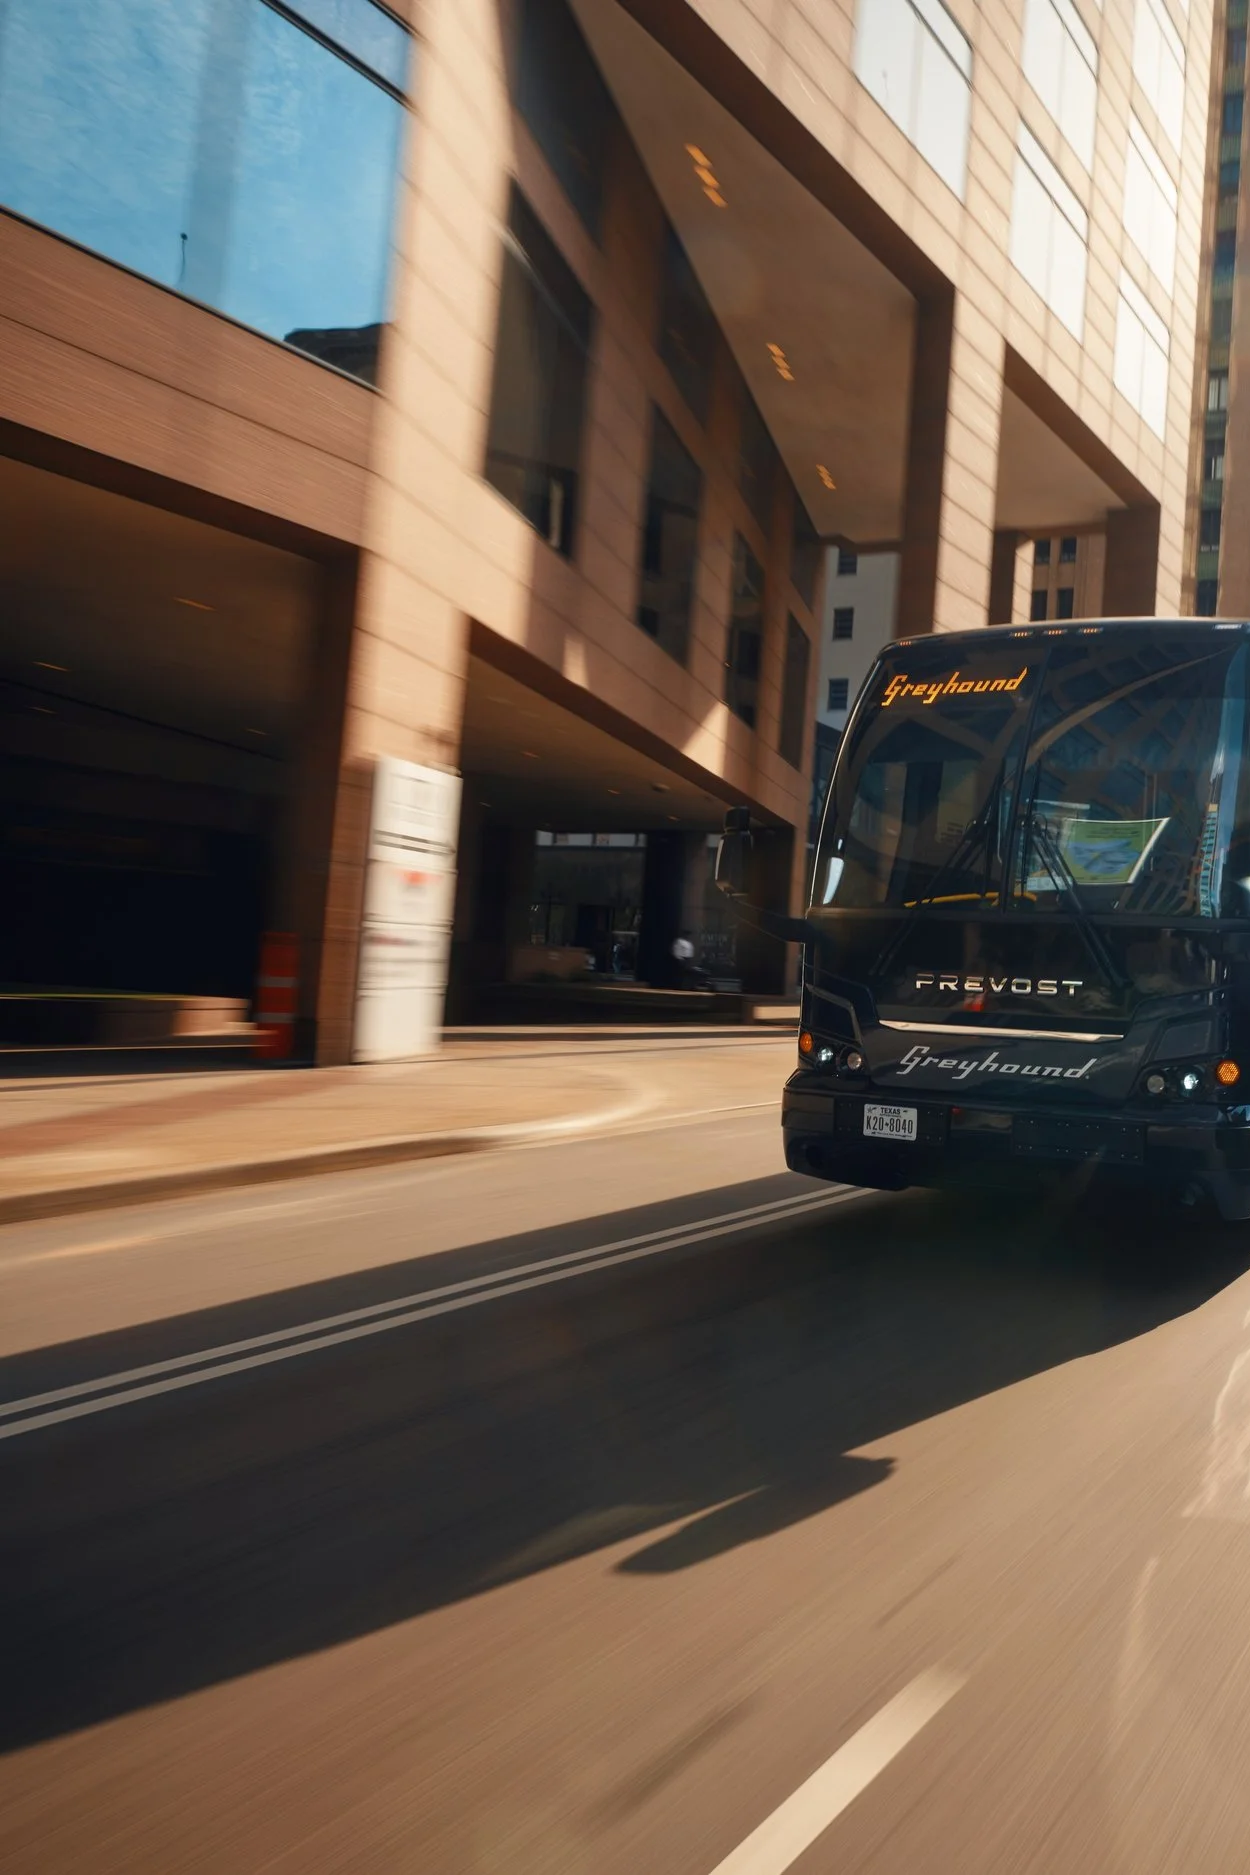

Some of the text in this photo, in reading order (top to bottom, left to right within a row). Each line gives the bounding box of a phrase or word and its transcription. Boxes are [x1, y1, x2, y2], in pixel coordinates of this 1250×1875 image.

[881, 666, 1028, 707] Greyhound
[915, 973, 1083, 997] PREVOST
[896, 1045, 1098, 1080] Greyhound
[880, 1107, 901, 1115] TEXAS
